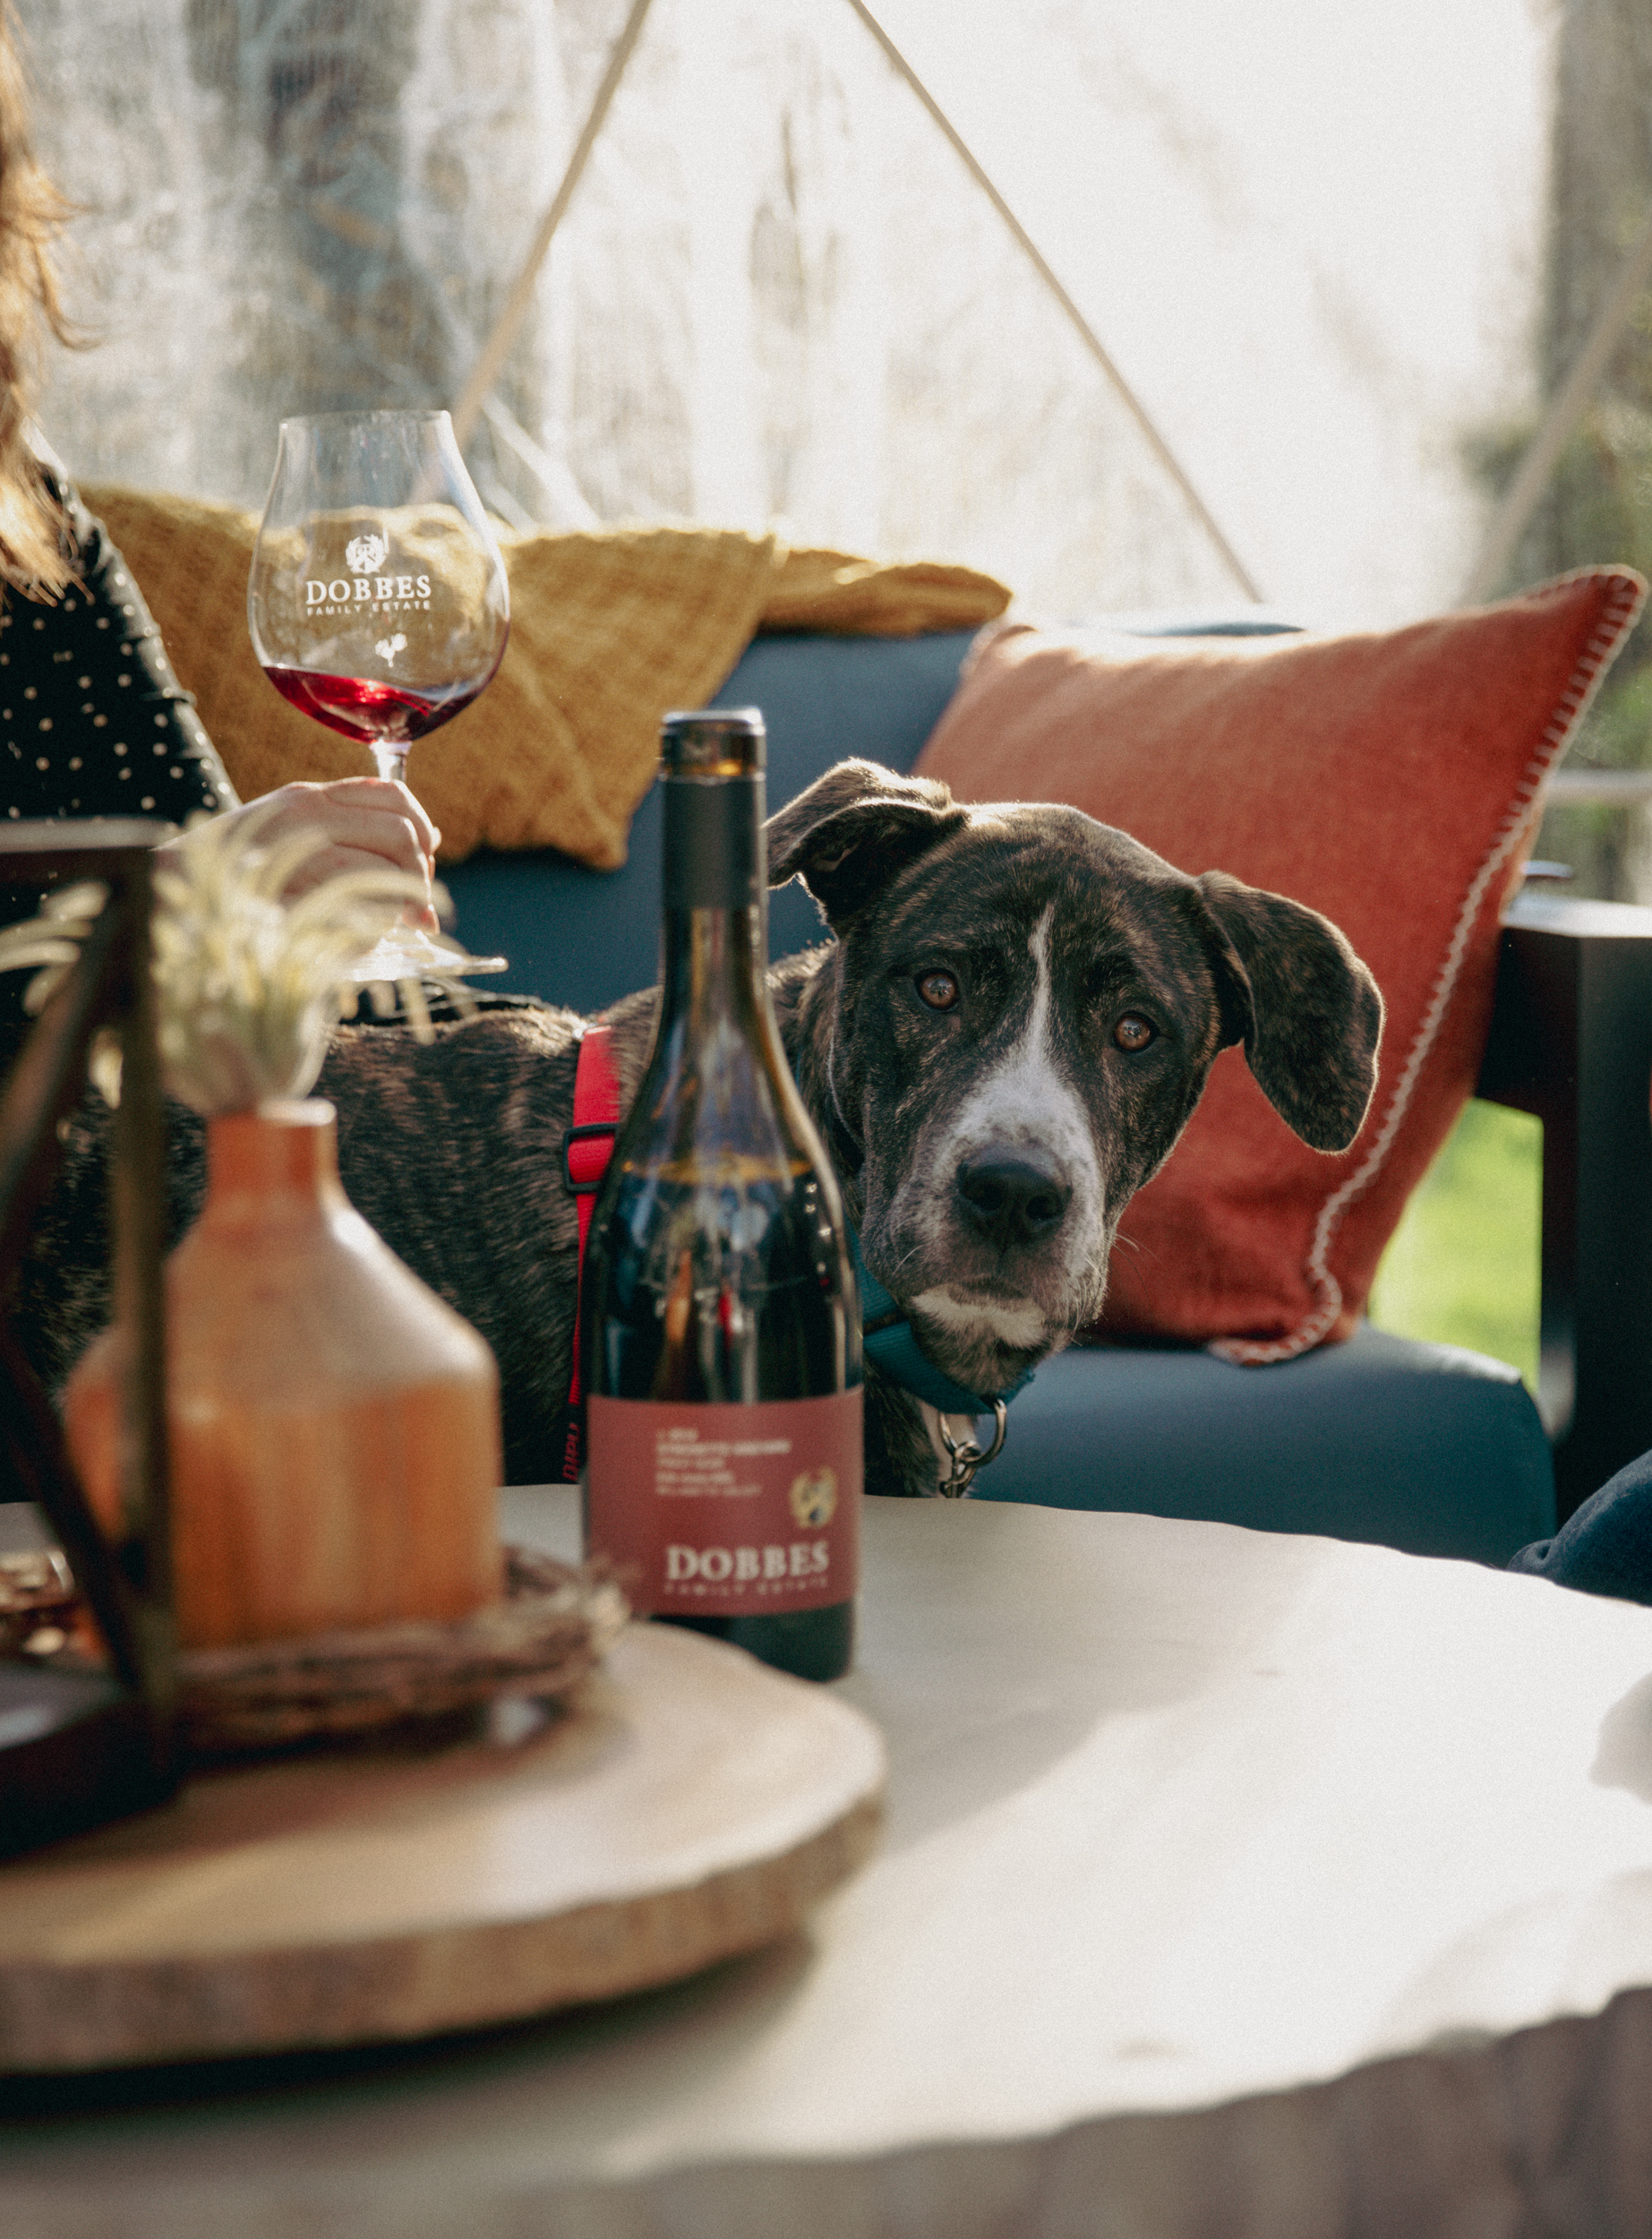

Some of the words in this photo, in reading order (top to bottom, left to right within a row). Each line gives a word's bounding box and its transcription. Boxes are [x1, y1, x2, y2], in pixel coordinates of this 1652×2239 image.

[305, 575, 432, 605] DOBBES
[306, 605, 362, 616] FAMILY
[372, 600, 431, 613] ESTATE
[667, 1540, 829, 1581] DOBBES
